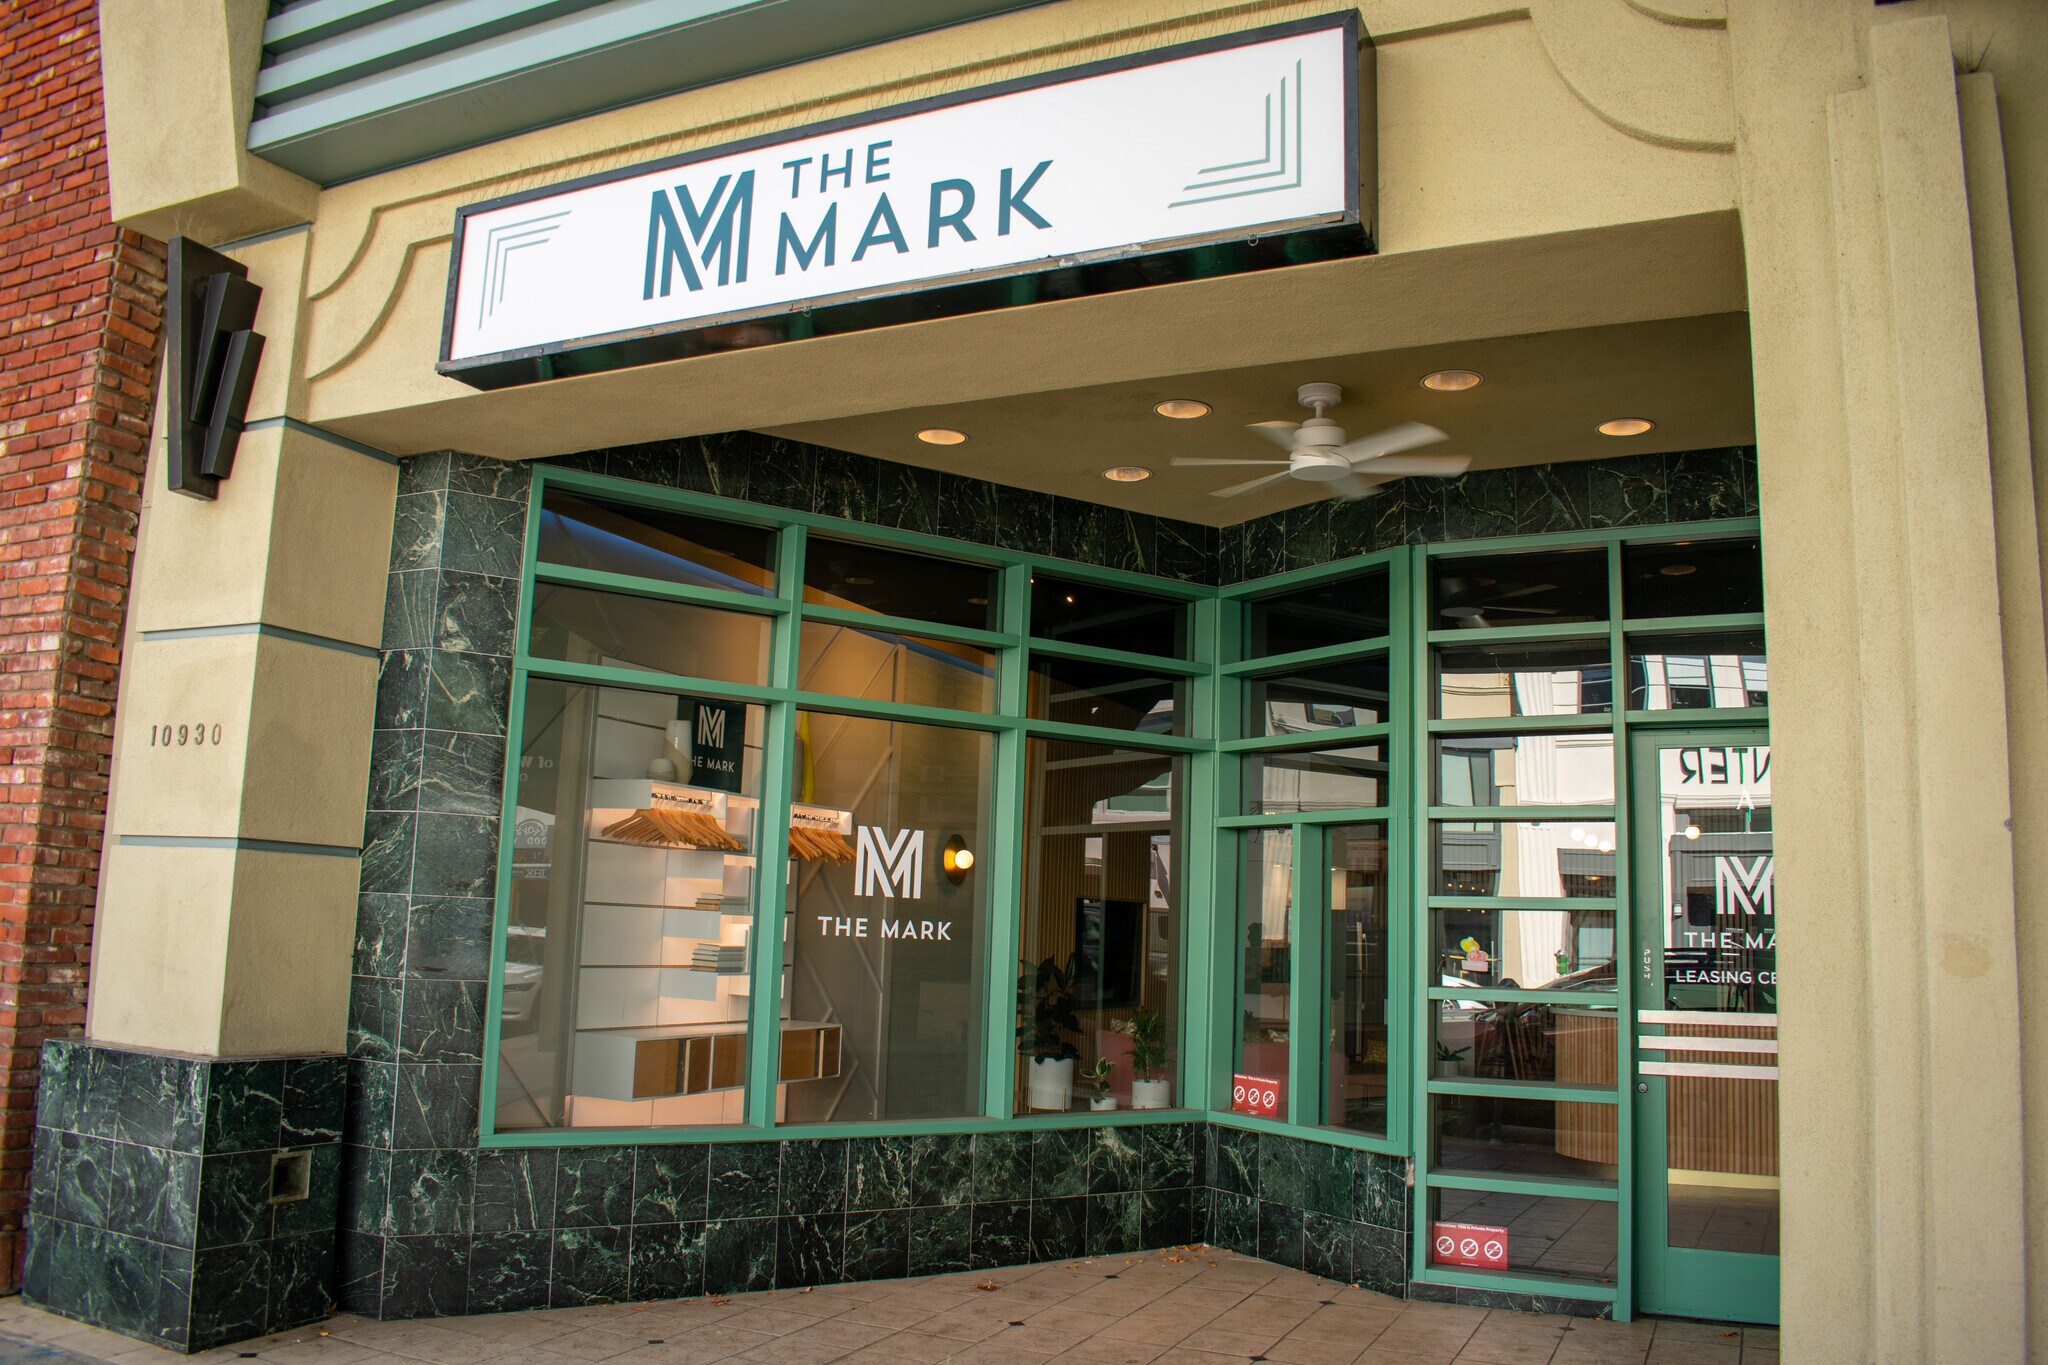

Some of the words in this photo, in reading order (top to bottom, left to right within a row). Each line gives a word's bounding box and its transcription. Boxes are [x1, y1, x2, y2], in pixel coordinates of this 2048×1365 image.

[782, 140, 893, 199] THE
[775, 159, 1054, 276] MARK
[151, 722, 223, 747] 10930
[692, 755, 704, 768] HE
[706, 757, 735, 773] MARK
[817, 915, 869, 938] THE
[880, 918, 952, 941] MARK
[1683, 931, 1733, 949] THE
[1643, 948, 1651, 980] PUSH
[1675, 969, 1752, 984] LEASING
